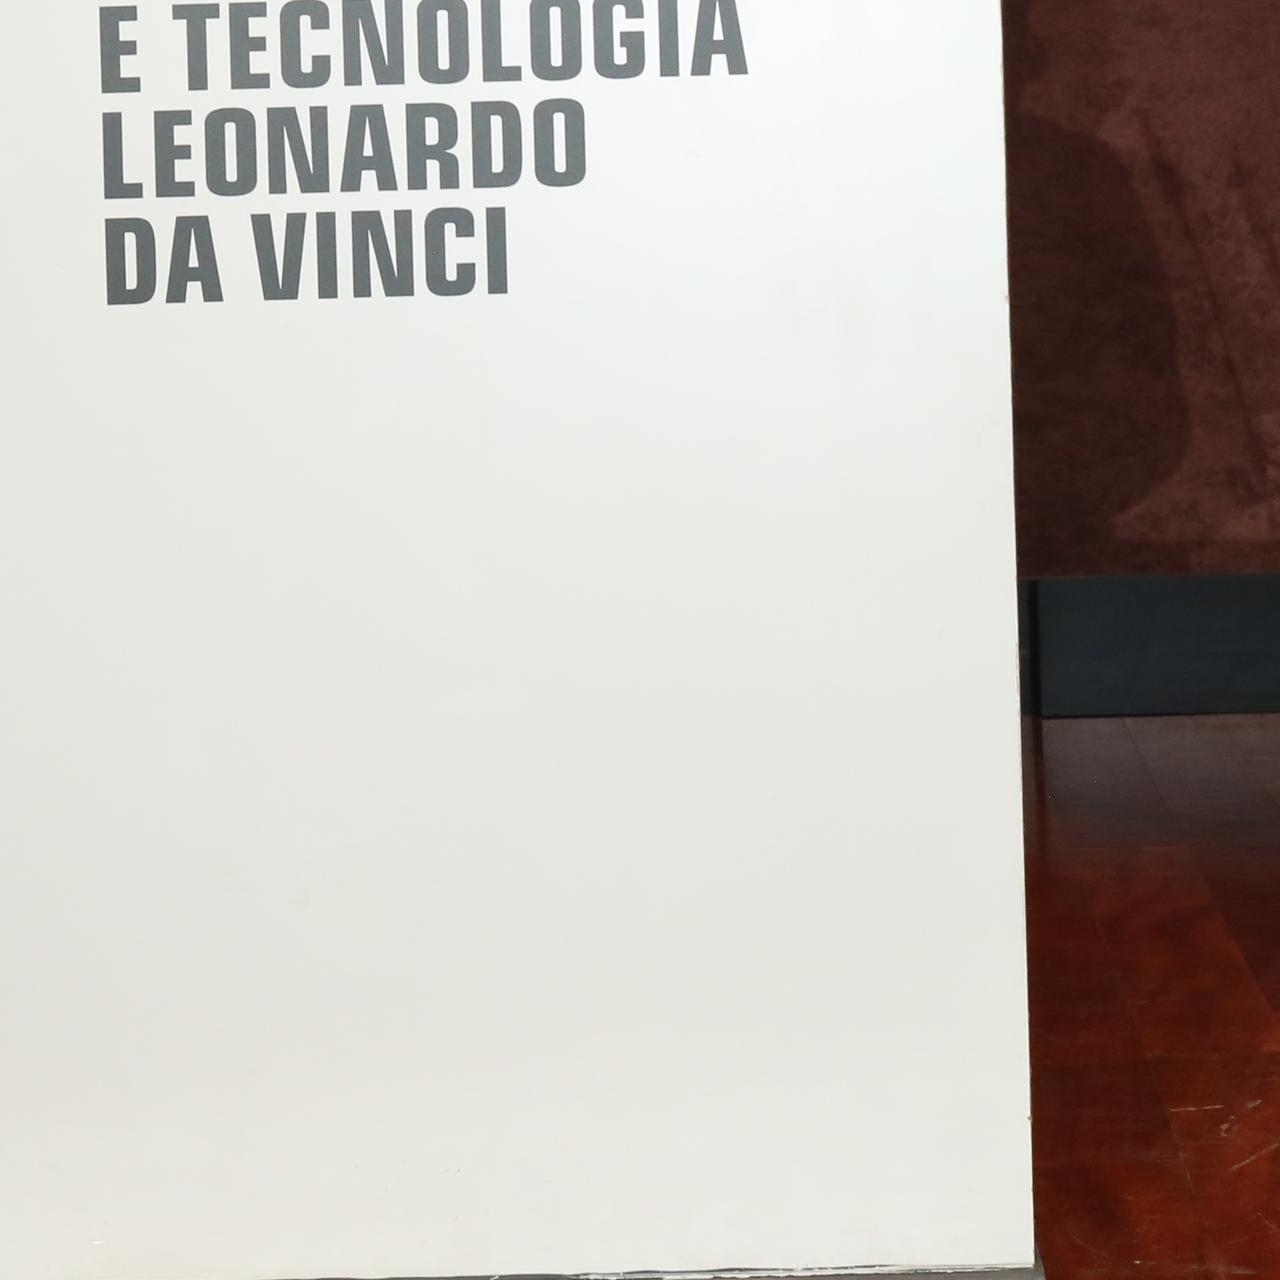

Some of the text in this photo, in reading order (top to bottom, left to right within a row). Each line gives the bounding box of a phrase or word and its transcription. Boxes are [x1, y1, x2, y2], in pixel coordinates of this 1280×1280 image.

[99, 5, 141, 94] E
[102, 98, 587, 200] LEONARDO
[105, 206, 508, 306] DA VINCI
